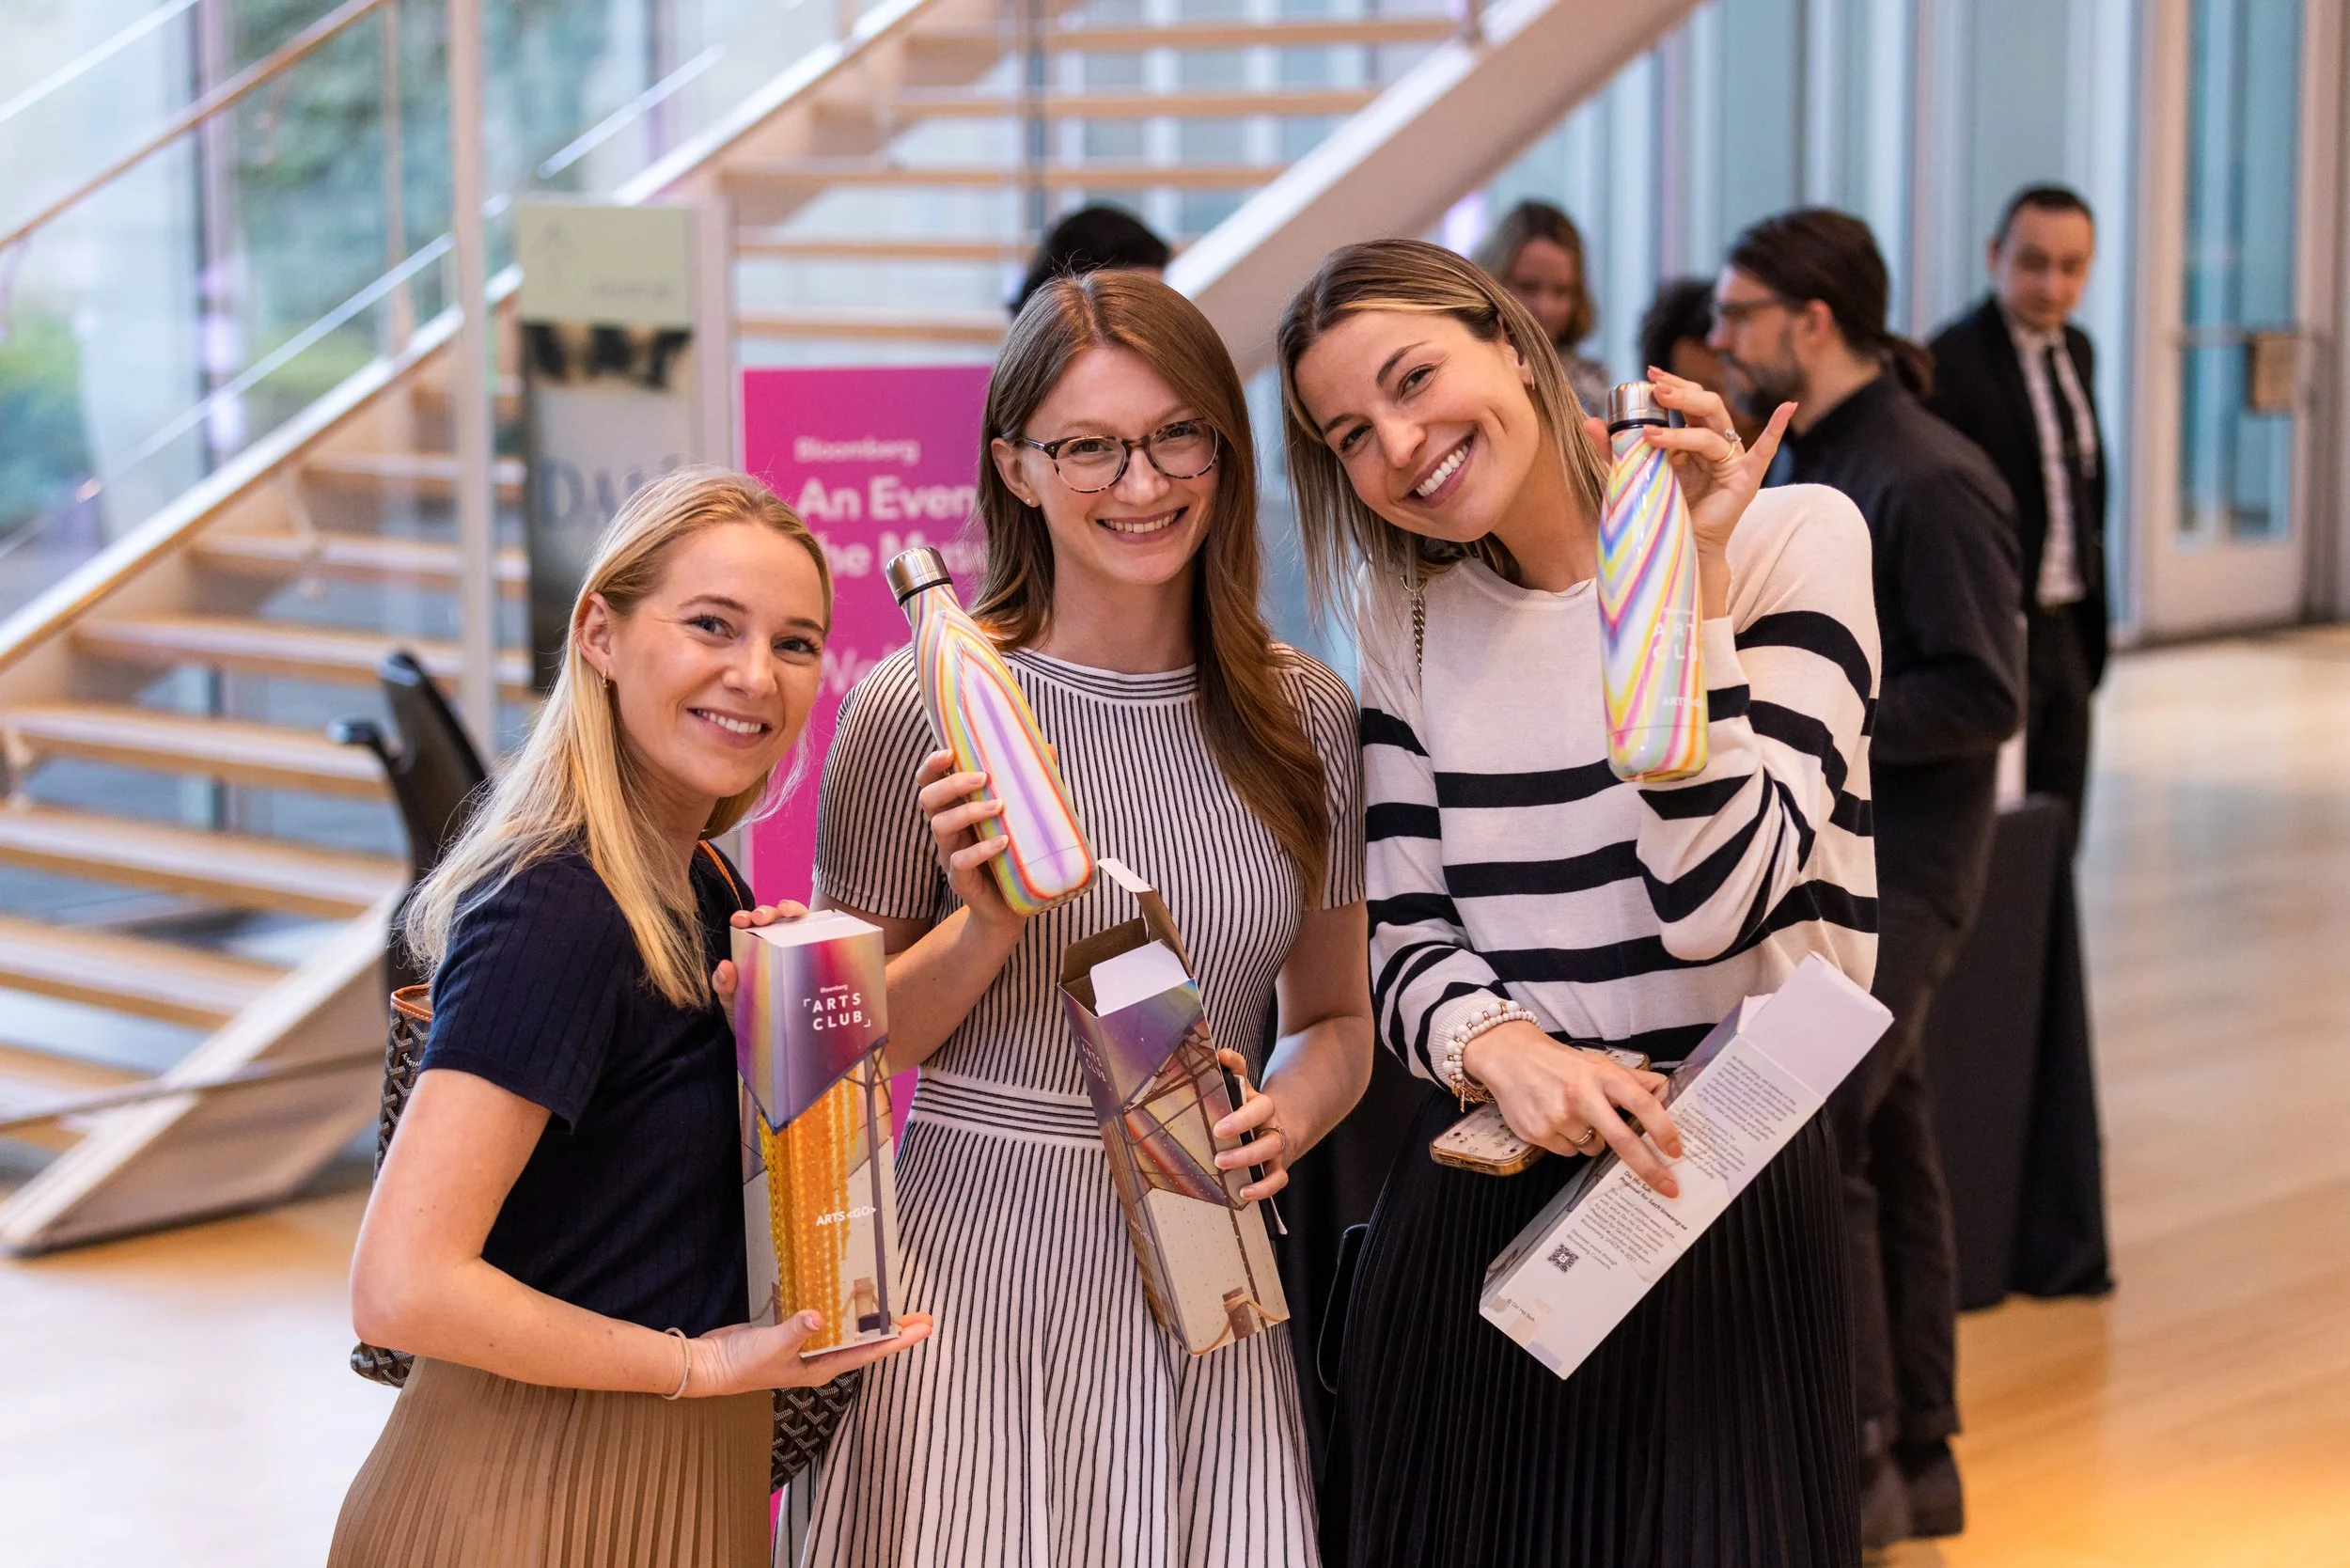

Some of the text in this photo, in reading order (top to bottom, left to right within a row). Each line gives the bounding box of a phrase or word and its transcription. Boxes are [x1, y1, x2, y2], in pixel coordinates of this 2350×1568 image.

[795, 436, 920, 466] Bloomberg
[800, 475, 977, 521] An Even
[816, 532, 872, 577] he
[812, 993, 861, 1013] ARTS
[813, 1011, 862, 1030] CLUB
[1082, 1043, 1103, 1068] ARTS
[816, 1210, 846, 1227] ARTS
